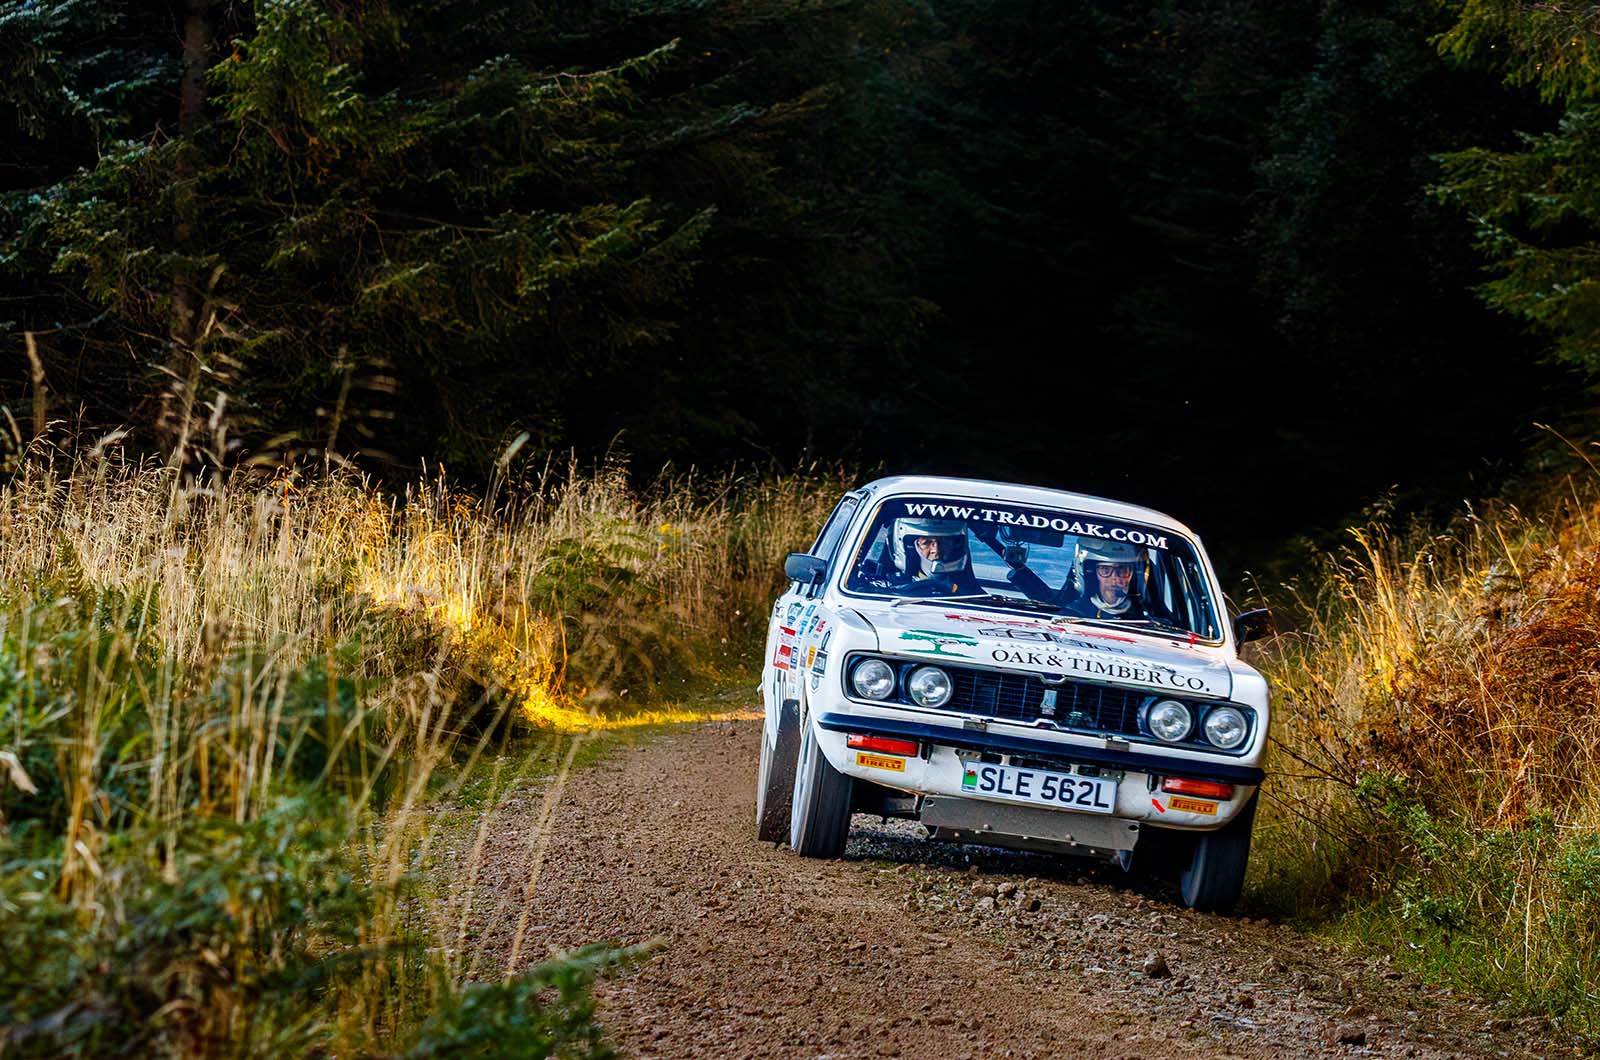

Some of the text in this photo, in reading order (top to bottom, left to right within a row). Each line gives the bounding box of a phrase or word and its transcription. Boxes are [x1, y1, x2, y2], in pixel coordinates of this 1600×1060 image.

[905, 502, 1169, 550] WWW.TRADOAK.COM
[991, 649, 1211, 692] OAK & TIMBER CO.
[860, 755, 903, 769] PIRELLI
[979, 767, 1110, 809] SLE 562L
